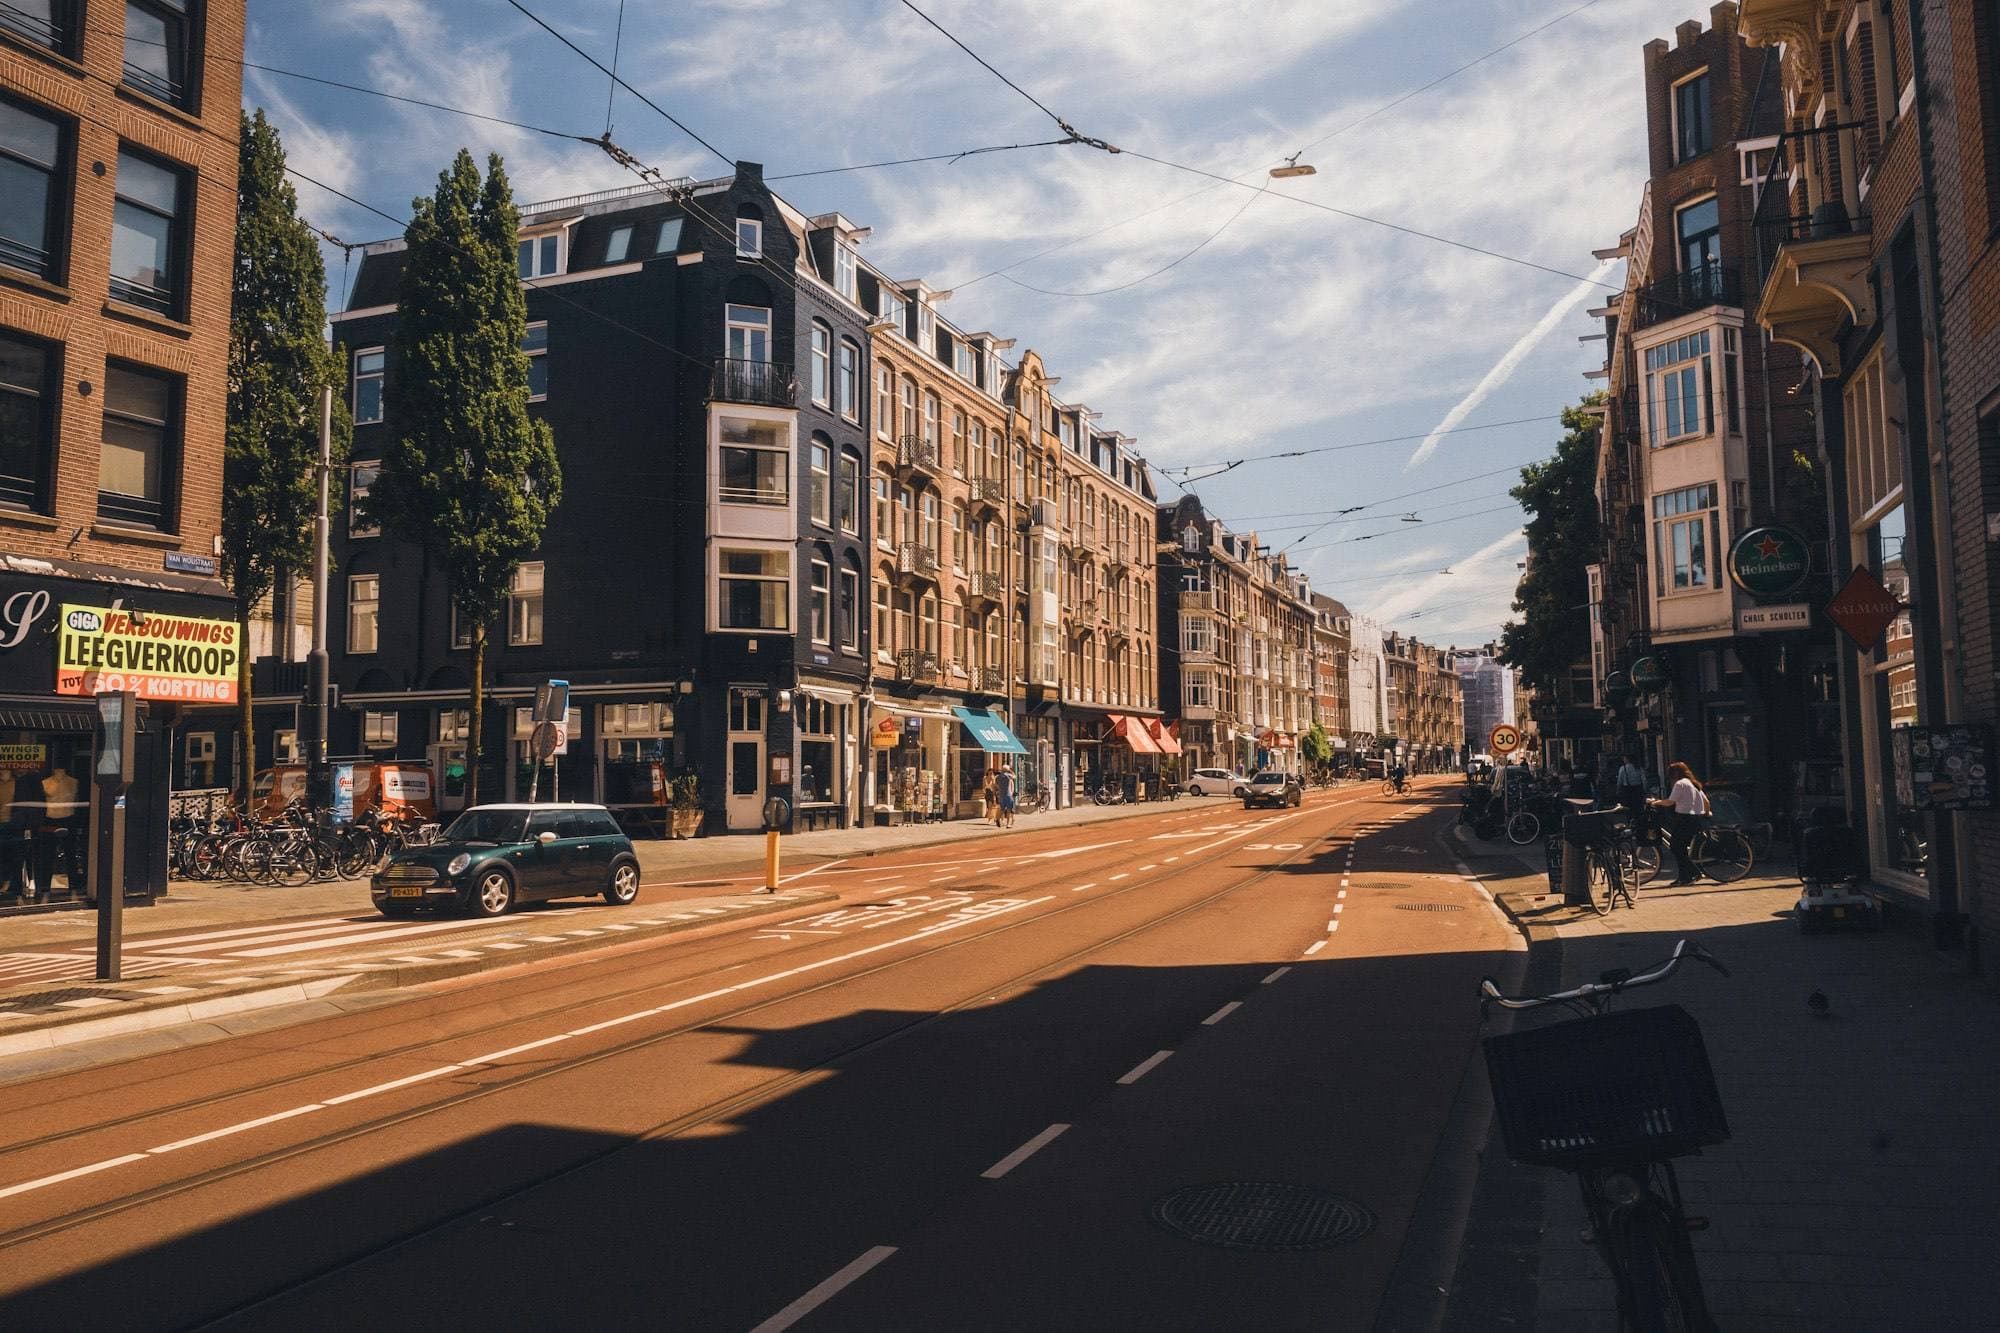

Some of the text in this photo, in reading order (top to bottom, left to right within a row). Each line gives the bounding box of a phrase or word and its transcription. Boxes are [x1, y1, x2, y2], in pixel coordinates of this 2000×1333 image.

[1741, 562, 1801, 575] Heineken
[1743, 611, 1806, 623] CHRIS SCHOLTEN
[69, 611, 99, 631] GIGA
[103, 612, 234, 645] VERBOUWINGS
[64, 634, 236, 676] LEEGVERKOOP
[61, 676, 81, 688] TOT
[147, 677, 230, 699] KORTING
[1496, 734, 1515, 745] 30
[1243, 843, 1303, 851] 30
